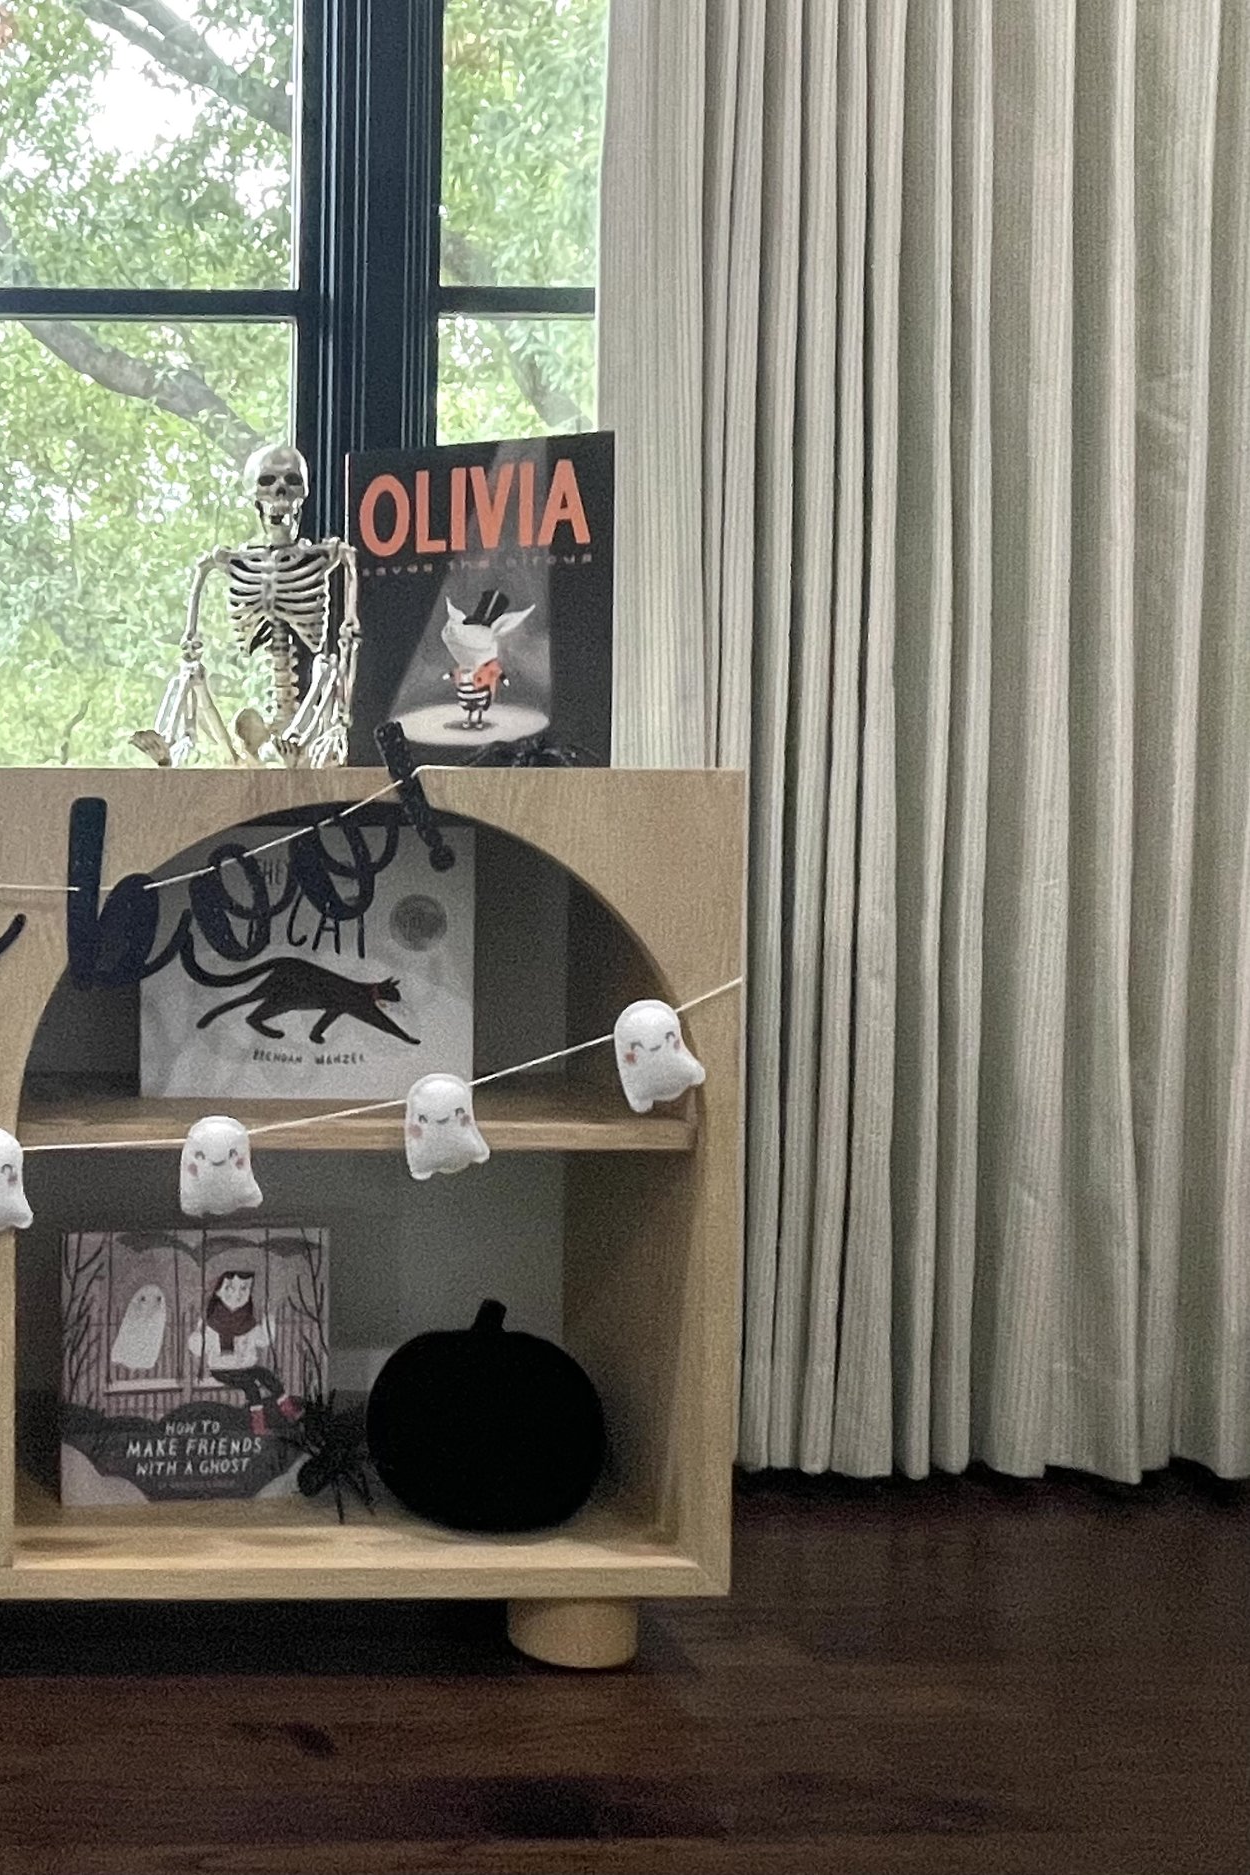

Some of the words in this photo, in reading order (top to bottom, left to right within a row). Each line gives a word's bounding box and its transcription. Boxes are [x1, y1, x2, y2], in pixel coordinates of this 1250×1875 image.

[359, 458, 591, 558] OLIVIA
[165, 1420, 196, 1436] HOW
[201, 1419, 221, 1435] TO
[126, 1438, 179, 1459] MAKE
[185, 1436, 263, 1457] FRIENDS
[136, 1459, 178, 1476] WITH
[183, 1460, 194, 1476] A
[198, 1457, 251, 1475] GHOST
